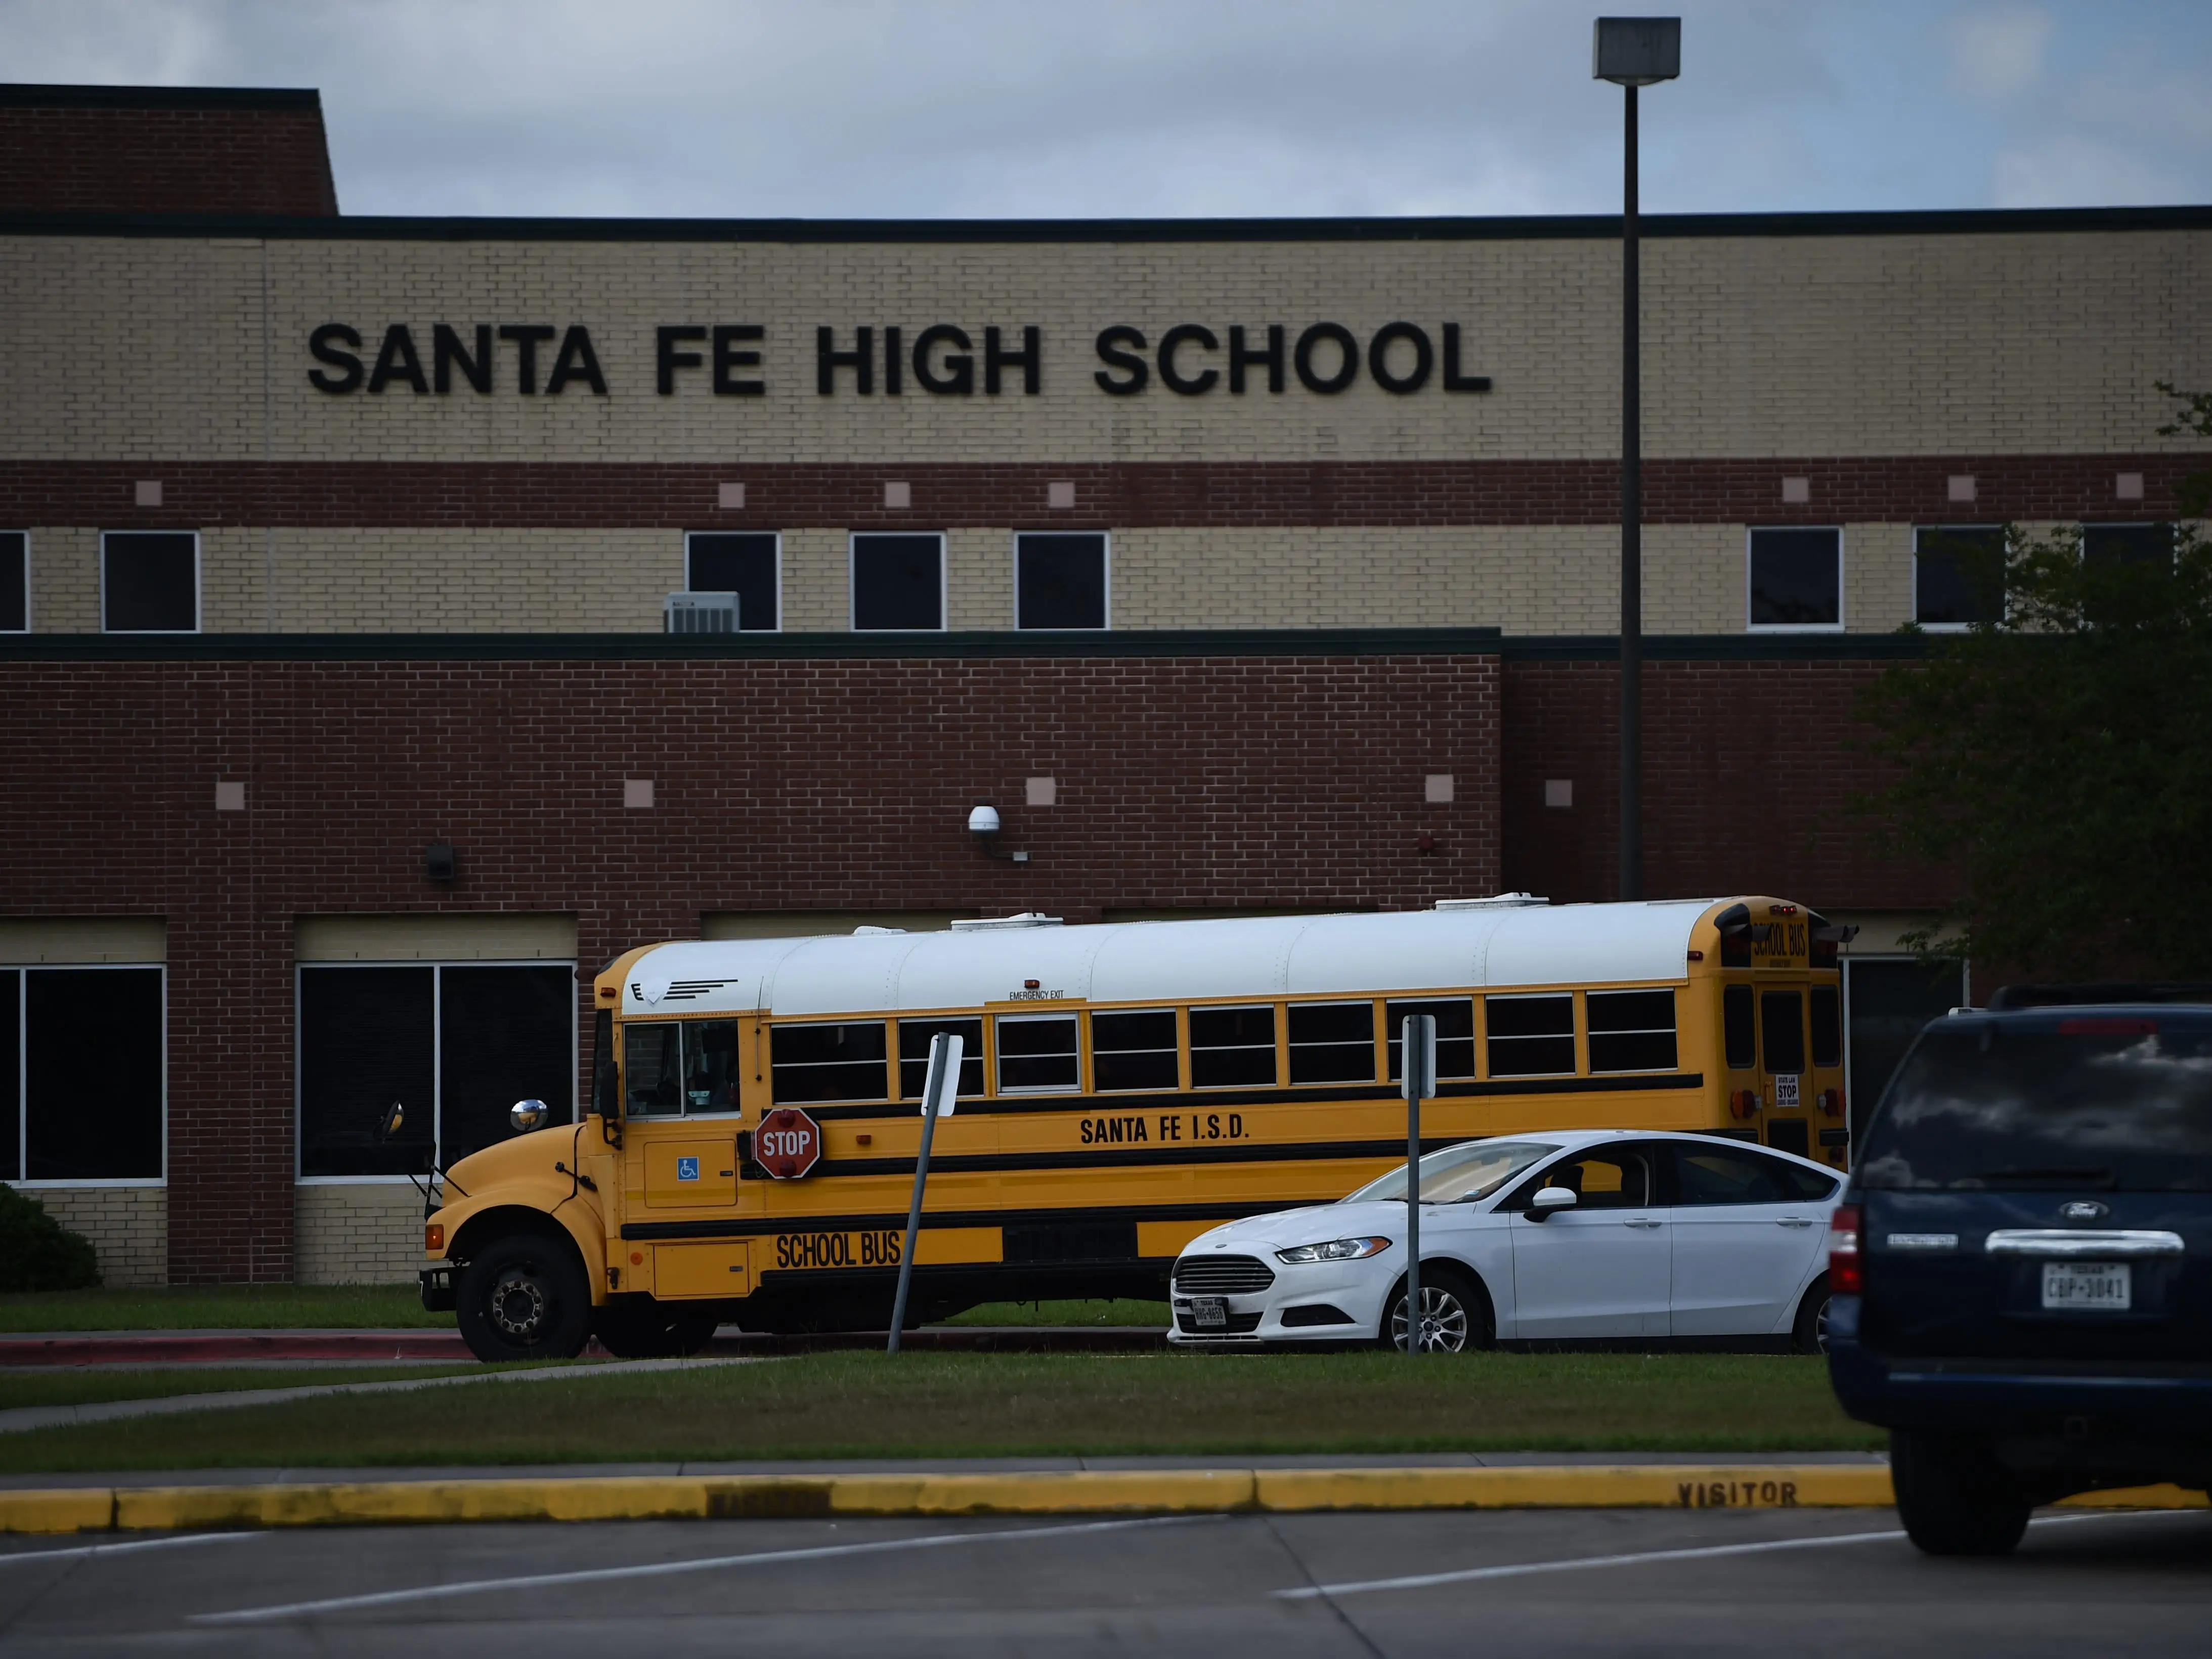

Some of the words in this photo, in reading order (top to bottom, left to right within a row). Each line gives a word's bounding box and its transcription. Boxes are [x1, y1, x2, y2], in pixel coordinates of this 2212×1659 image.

[308, 324, 607, 394] SANTA
[657, 324, 764, 394] FE
[817, 323, 1040, 395] HIGH
[1095, 322, 1490, 393] SCHOOL
[1789, 923, 1805, 956] BUS
[1010, 990, 1049, 1000] EMERGENCY
[1051, 990, 1064, 998] EXIT
[1779, 1085, 1796, 1098] STOP
[1081, 1117, 1147, 1143] SANTA
[1160, 1116, 1181, 1140] FE
[1193, 1114, 1249, 1139] I.S.D.
[764, 1131, 810, 1156] STOP
[777, 1233, 856, 1268] SCHOOL
[861, 1231, 900, 1264] BUS
[1679, 1481, 1797, 1507] VISITOR
